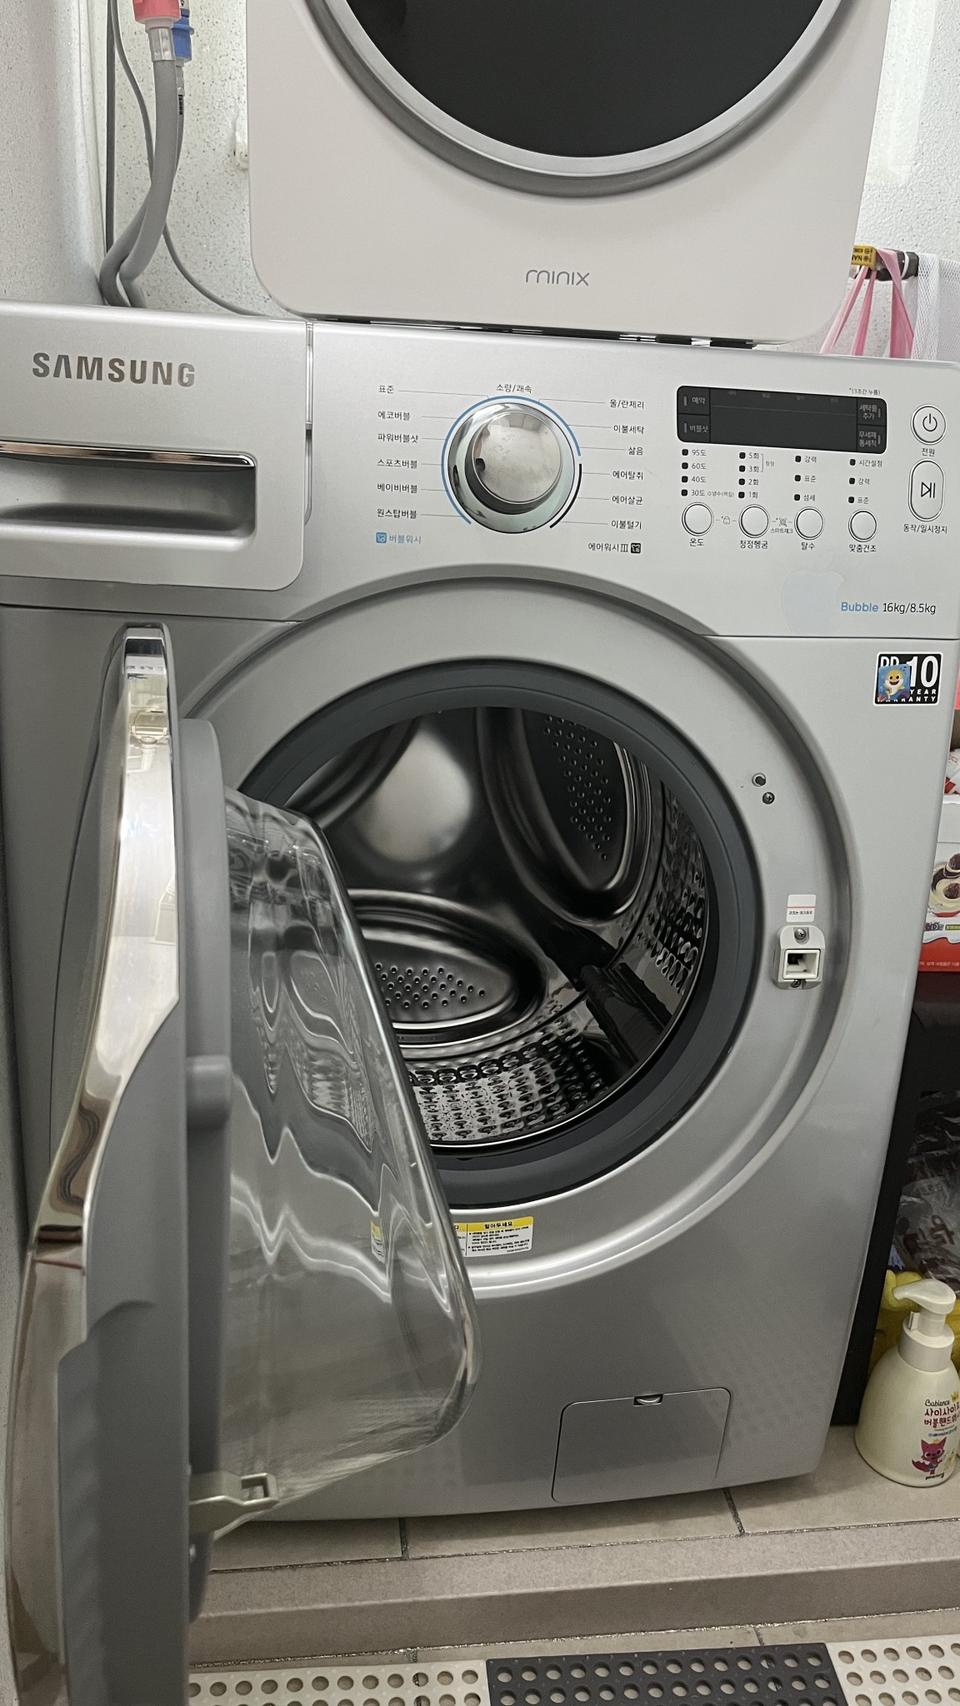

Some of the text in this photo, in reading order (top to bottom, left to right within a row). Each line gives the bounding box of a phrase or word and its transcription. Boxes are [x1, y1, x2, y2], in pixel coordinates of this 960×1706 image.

[525, 269, 590, 286] minix
[32, 352, 195, 387] SAMSUNG
[378, 385, 394, 394] 표준
[496, 383, 532, 394] 소량/쾌속
[609, 398, 645, 410] 울/란제리
[377, 410, 410, 421] 에코버블
[613, 424, 645, 434] 이불세탁
[689, 424, 709, 434] 버블샷
[377, 433, 419, 444] 파워버블샷
[628, 446, 644, 456] 삶음
[691, 449, 706, 457] 95도
[748, 452, 760, 460] 5회
[921, 447, 935, 457] 전원
[376, 458, 418, 469] 스포츠버블
[804, 455, 817, 463] 강력
[858, 459, 883, 468] 시간설정
[691, 462, 706, 470] 60도
[748, 465, 760, 473] 3회
[612, 470, 644, 480] 에어탈취
[691, 475, 706, 483] 40도
[804, 474, 816, 482] 표준
[748, 478, 759, 486] 2회
[858, 477, 870, 486] 강력
[377, 483, 418, 494] 베이비버블
[691, 489, 705, 497] 30도
[611, 495, 643, 505] 에어살균
[748, 491, 759, 499] 1회
[857, 496, 869, 505] 표준
[611, 519, 642, 530] 이불털기
[903, 523, 948, 534] 동작/일시정지
[389, 534, 422, 544] 버블워시
[689, 537, 704, 547] 온도
[740, 539, 768, 549] 청정헹굼
[801, 541, 815, 551] 탈수
[848, 543, 876, 552] 맞춤건조
[840, 602, 937, 615] Bubble 16kg/8.5kg
[906, 655, 939, 688] 10
